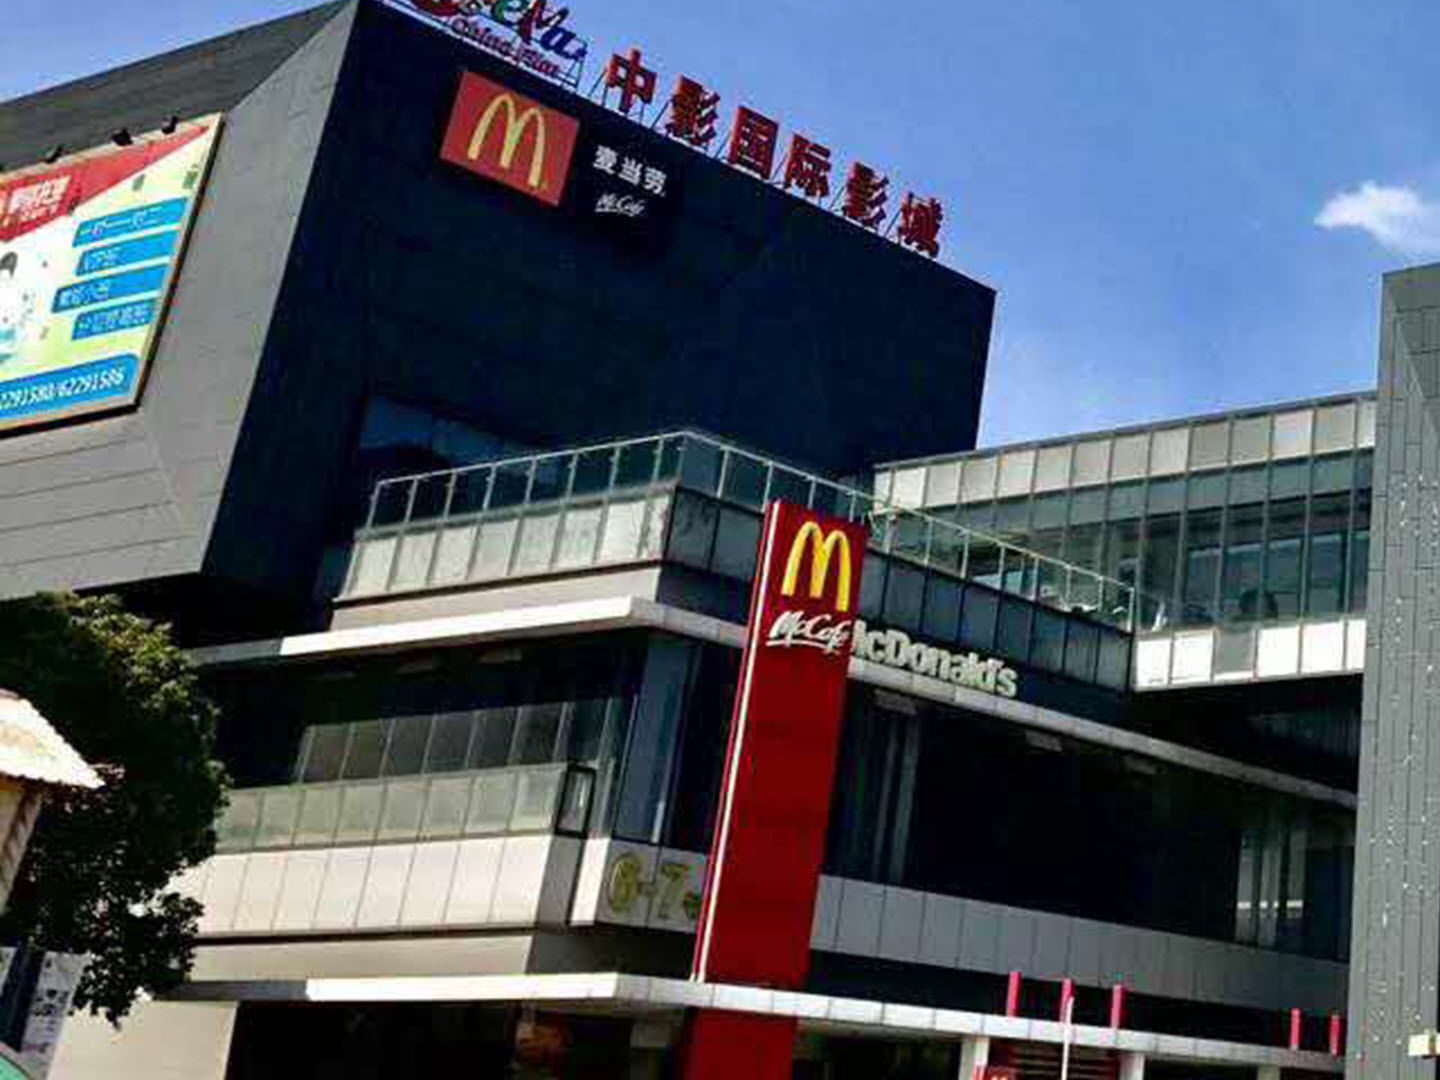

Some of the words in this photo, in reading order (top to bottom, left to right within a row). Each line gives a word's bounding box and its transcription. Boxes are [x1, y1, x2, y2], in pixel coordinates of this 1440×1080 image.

[593, 144, 667, 197] 麦当劳
[606, 48, 943, 258] 中影国际影城
